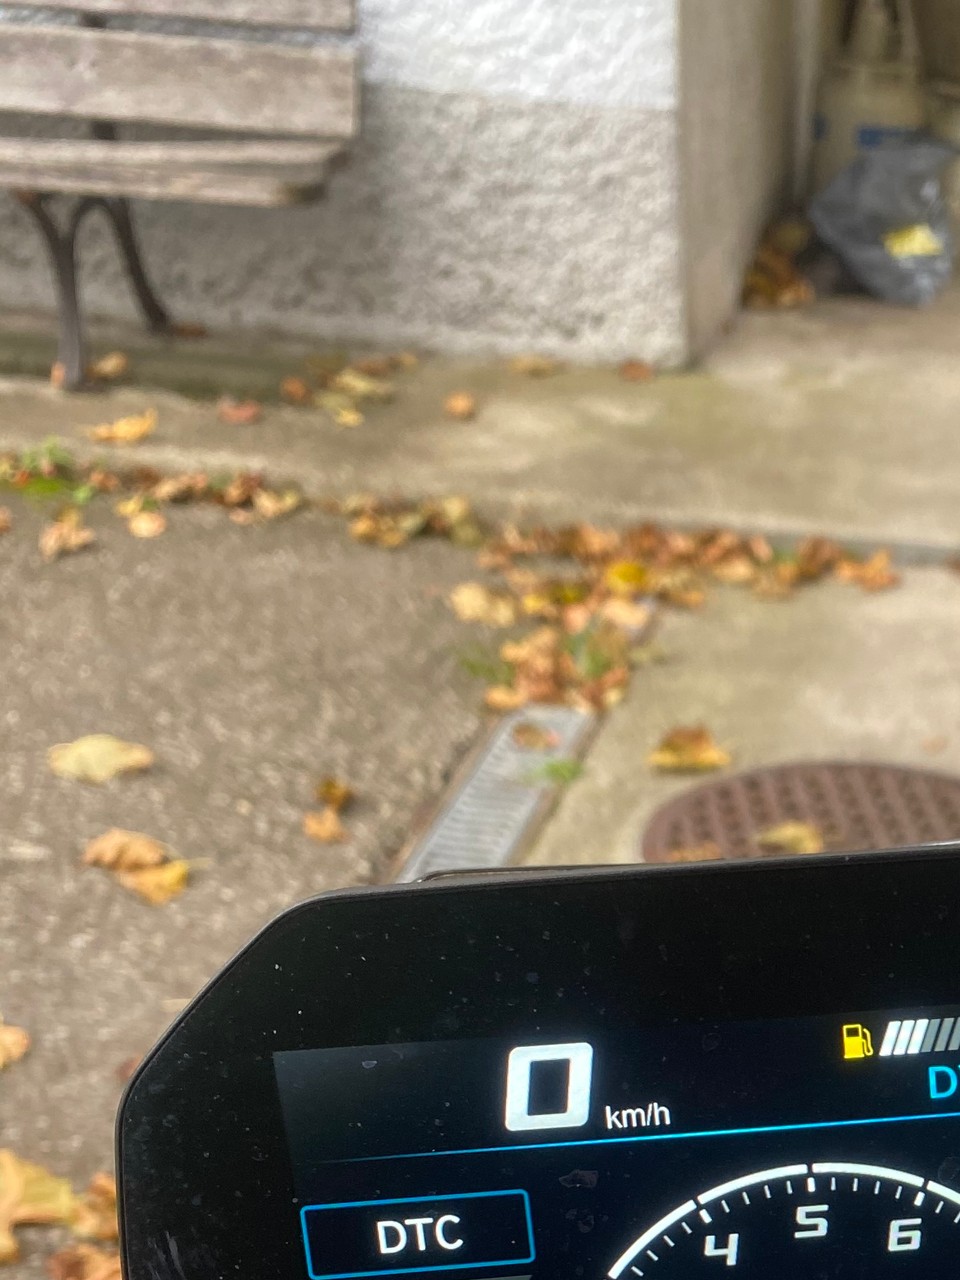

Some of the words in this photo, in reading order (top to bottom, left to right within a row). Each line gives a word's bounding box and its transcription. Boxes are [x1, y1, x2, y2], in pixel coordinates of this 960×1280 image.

[504, 1041, 594, 1132] 0
[605, 1102, 671, 1130] km/h
[376, 1214, 464, 1254] DTC
[794, 1204, 829, 1239] 5
[887, 1217, 922, 1252] 6
[703, 1233, 740, 1266] 4
